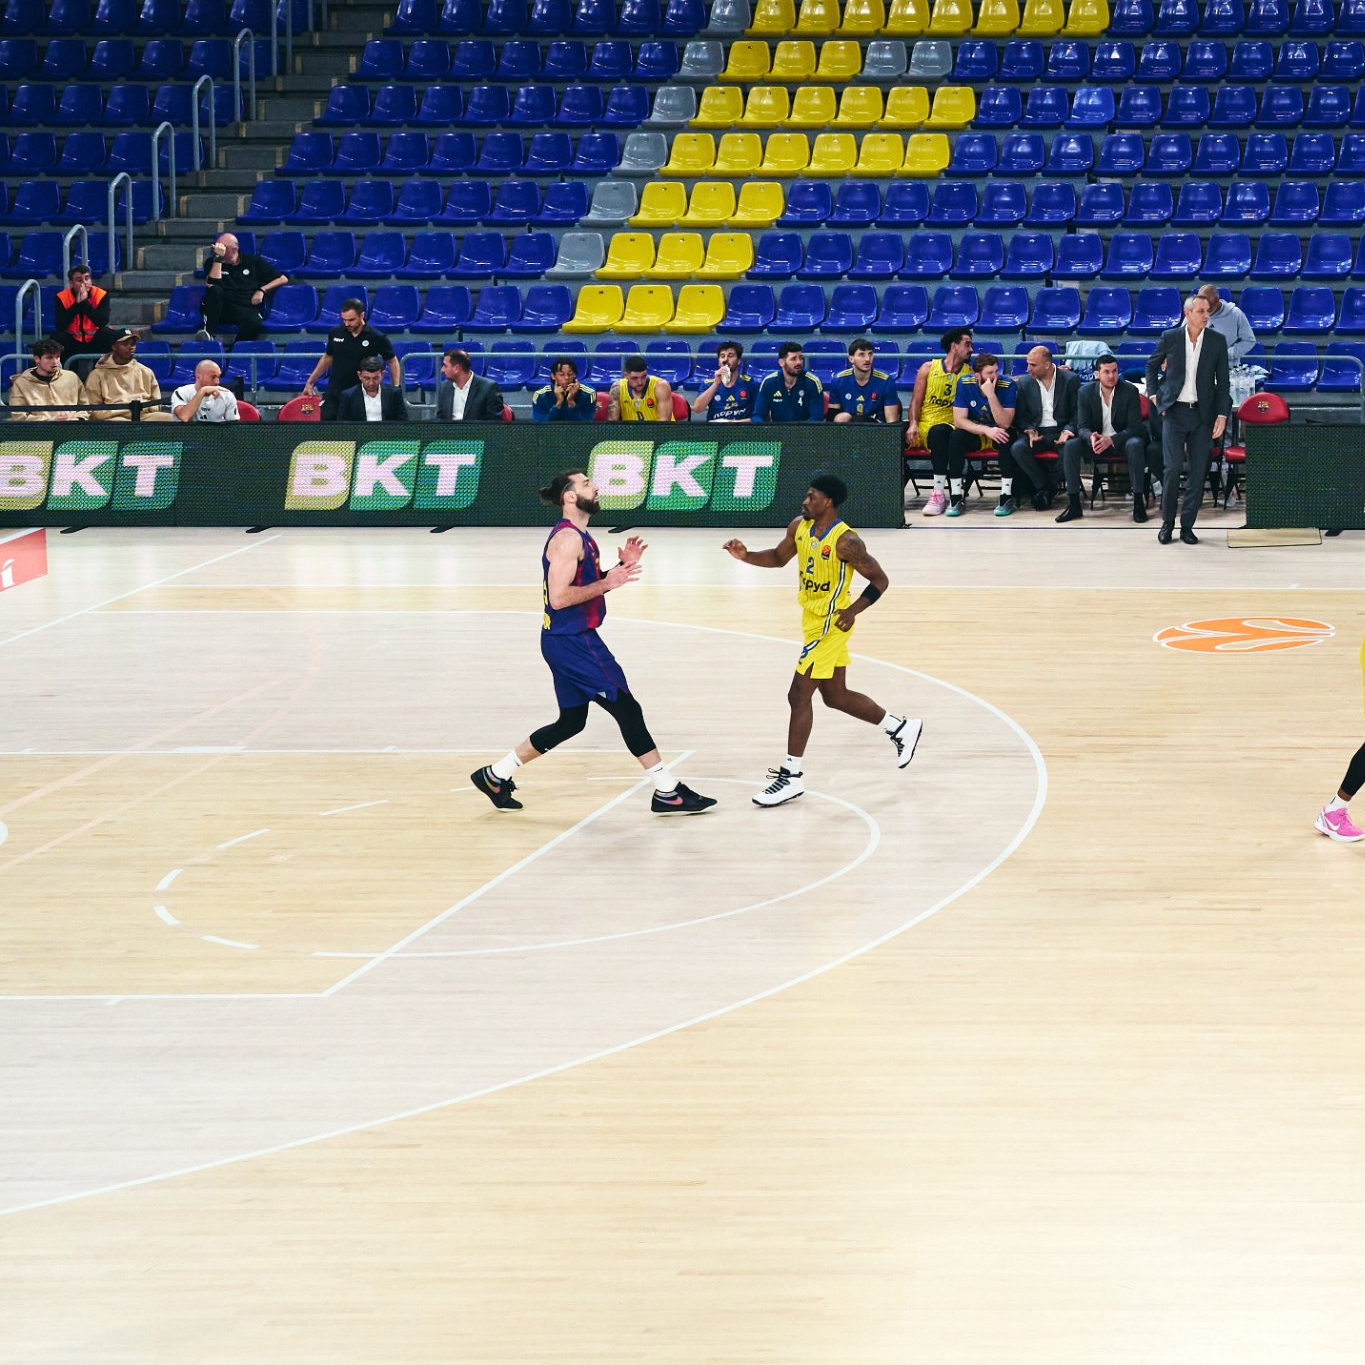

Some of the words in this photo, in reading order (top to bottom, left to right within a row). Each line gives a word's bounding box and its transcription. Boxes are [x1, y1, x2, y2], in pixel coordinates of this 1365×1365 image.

[291, 454, 476, 498] BKT
[593, 453, 775, 498] BKT
[806, 557, 814, 574] 2
